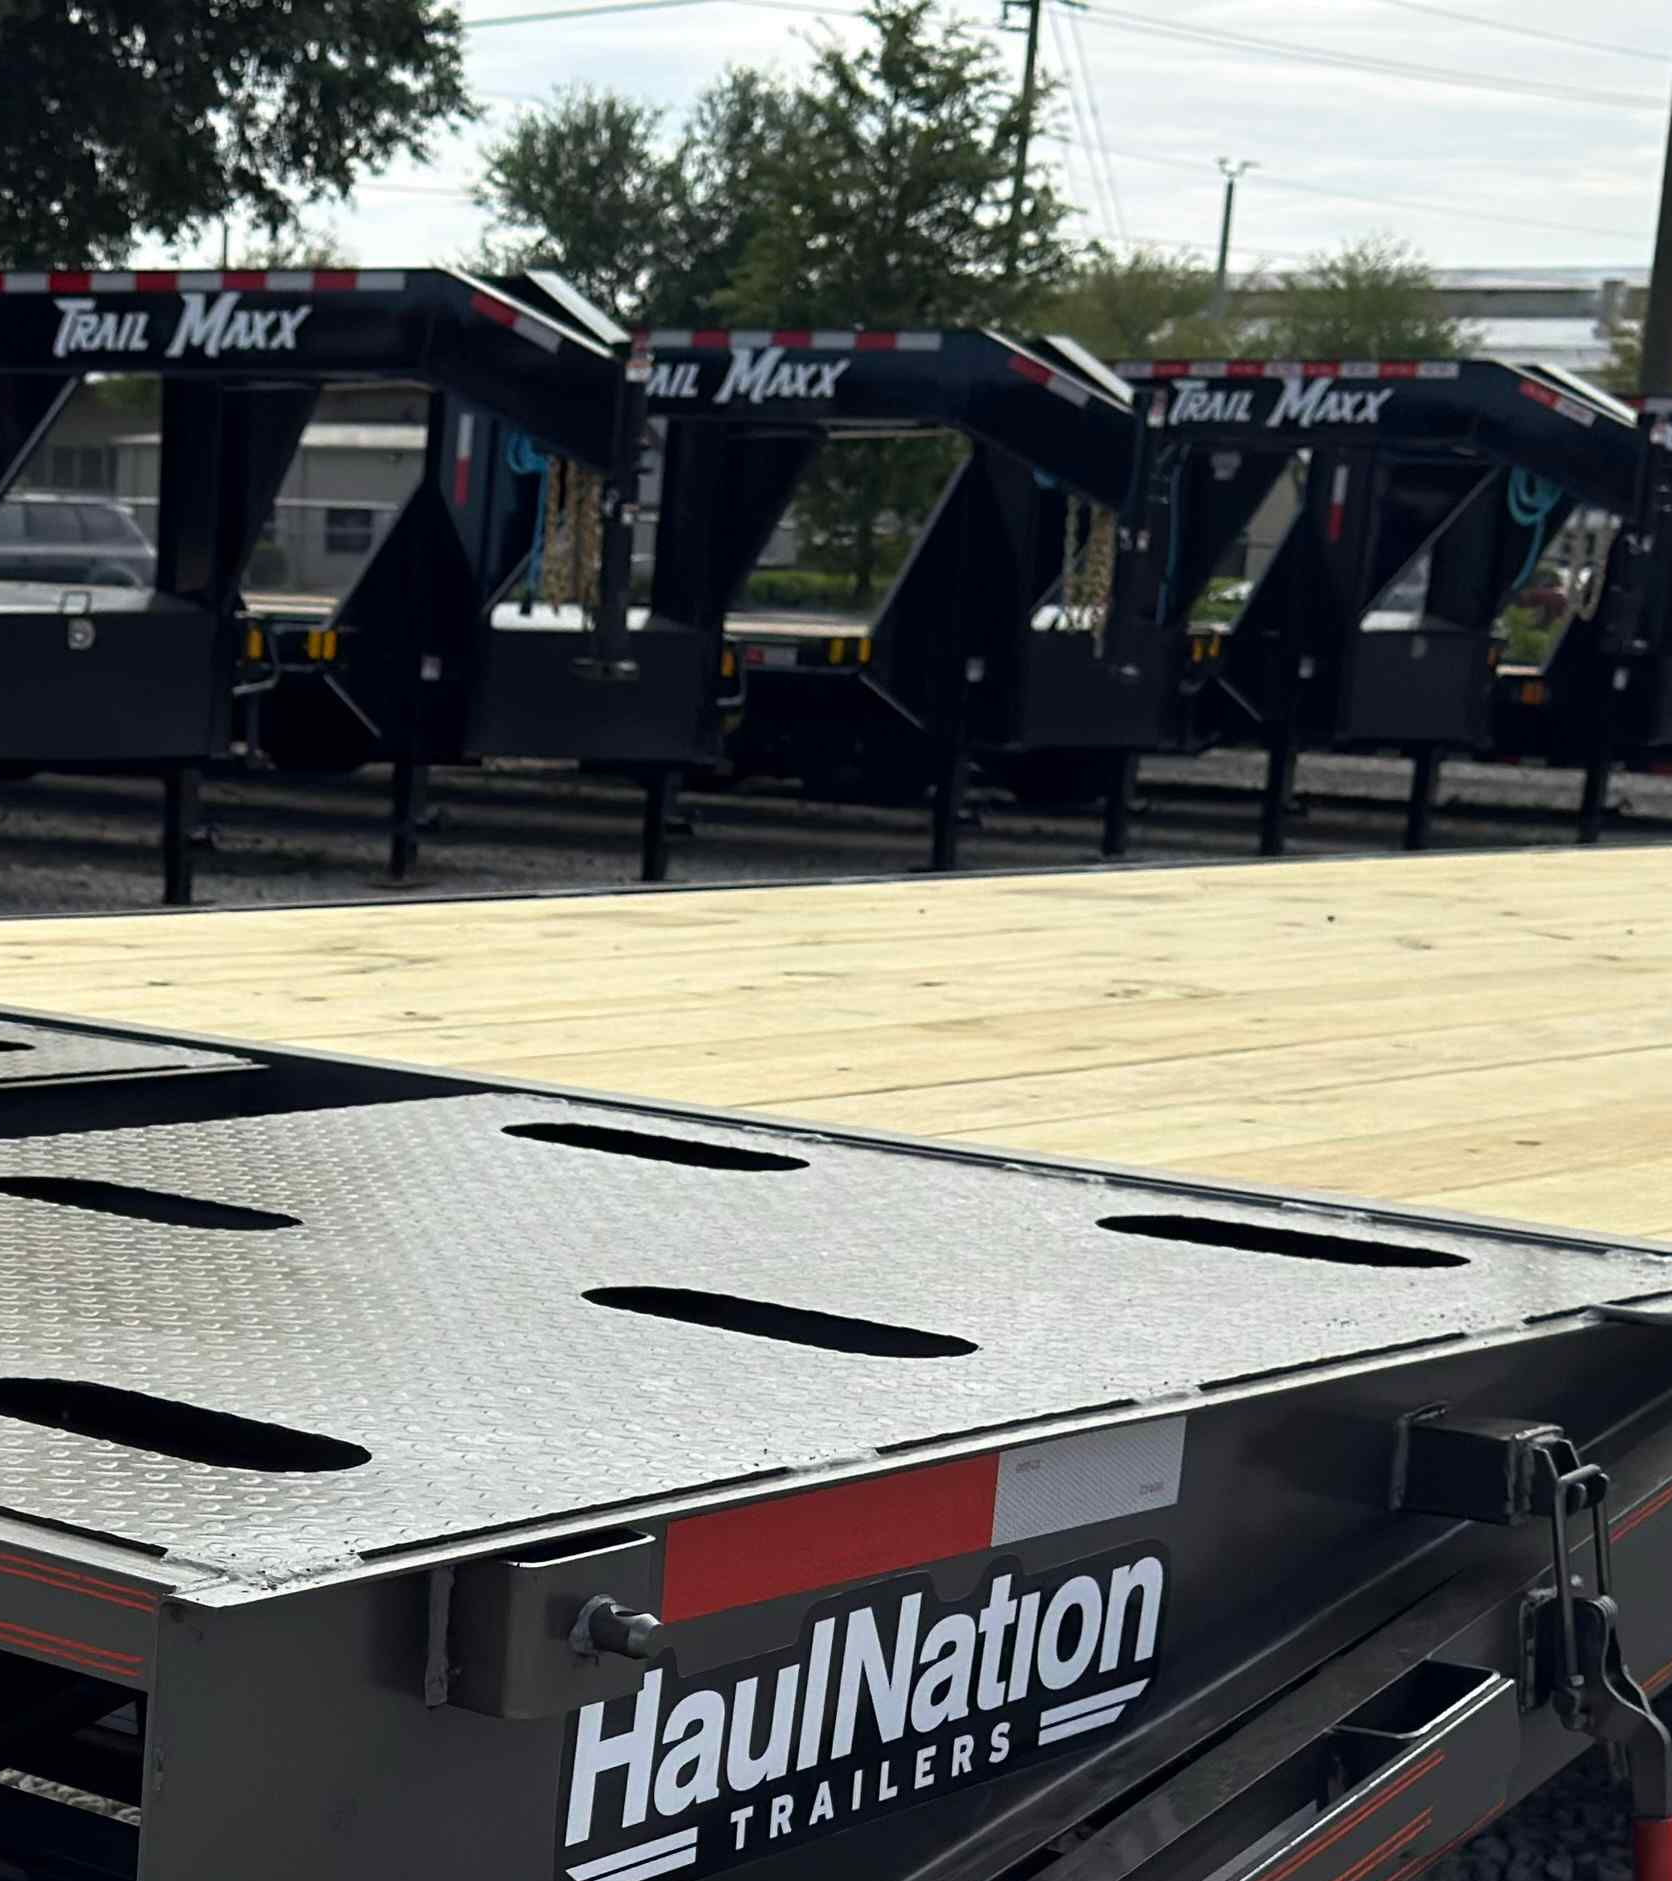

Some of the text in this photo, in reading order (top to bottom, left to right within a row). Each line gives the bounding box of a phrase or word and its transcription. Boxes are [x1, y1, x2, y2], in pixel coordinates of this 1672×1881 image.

[53, 291, 312, 358] TRAIL MAXX
[645, 346, 851, 403] AIL MAXX
[1168, 375, 1395, 427] TRAIL MAXX
[565, 1556, 1164, 1847] HaulNation
[731, 1721, 1011, 1851] TRAILERS
